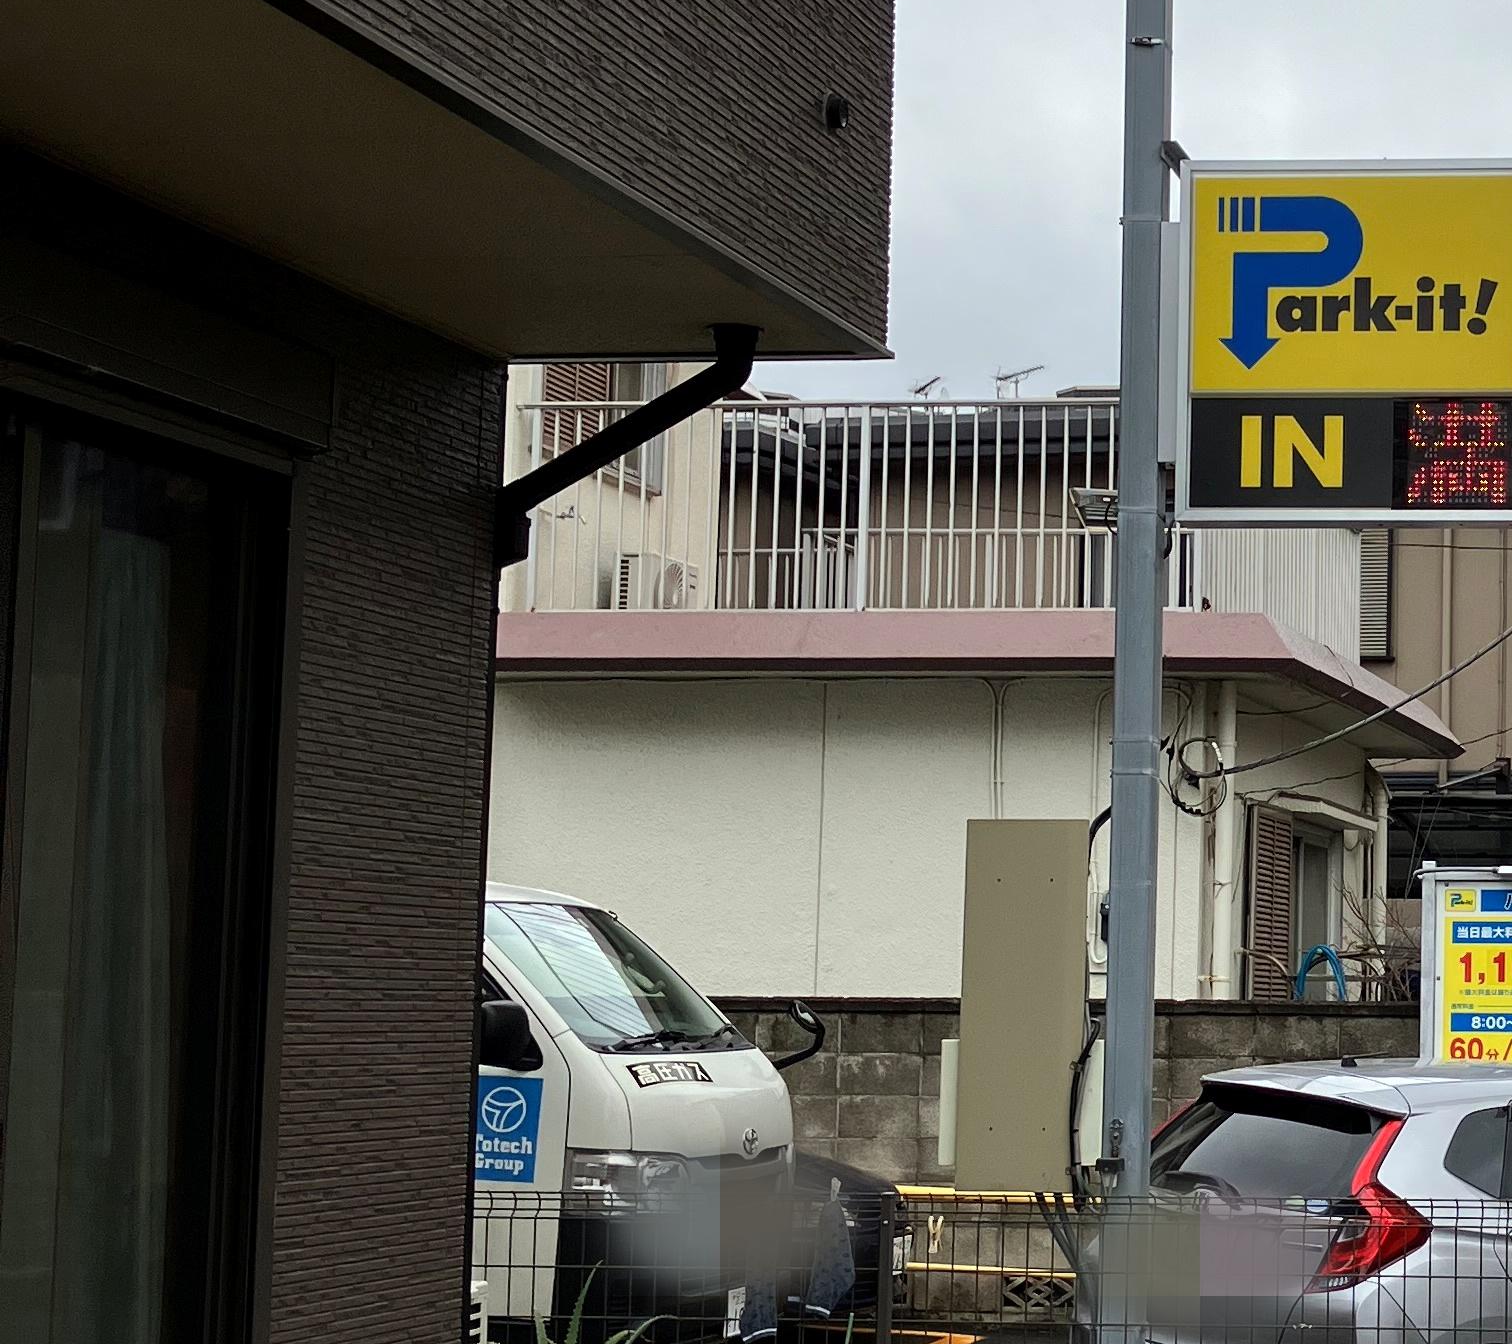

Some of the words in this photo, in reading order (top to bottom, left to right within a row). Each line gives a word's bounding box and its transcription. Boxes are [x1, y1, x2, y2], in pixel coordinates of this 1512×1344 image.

[1218, 196, 1498, 370] Park-it!
[1240, 415, 1344, 488] IN
[1408, 402, 1506, 504] 満
[631, 1062, 710, 1086] 高圧ガス
[474, 1152, 525, 1176] Group
